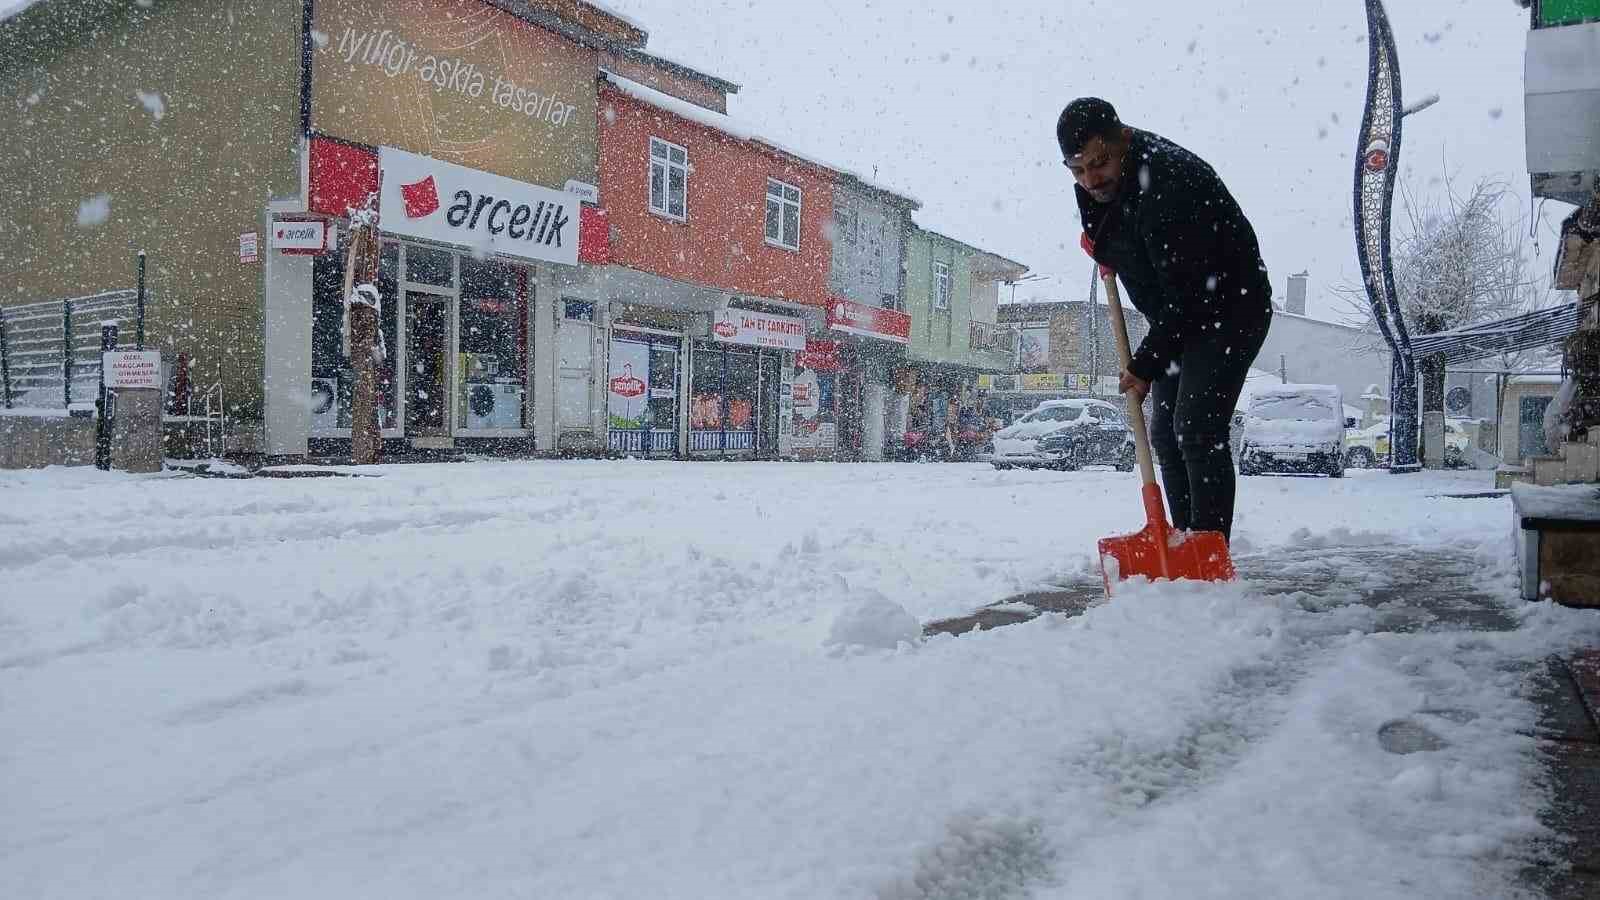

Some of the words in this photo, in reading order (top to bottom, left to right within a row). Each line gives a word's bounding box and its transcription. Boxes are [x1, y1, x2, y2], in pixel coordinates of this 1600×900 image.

[420, 55, 484, 97] aşkla
[491, 77, 577, 127] tasarlar
[447, 190, 568, 247] arçelik
